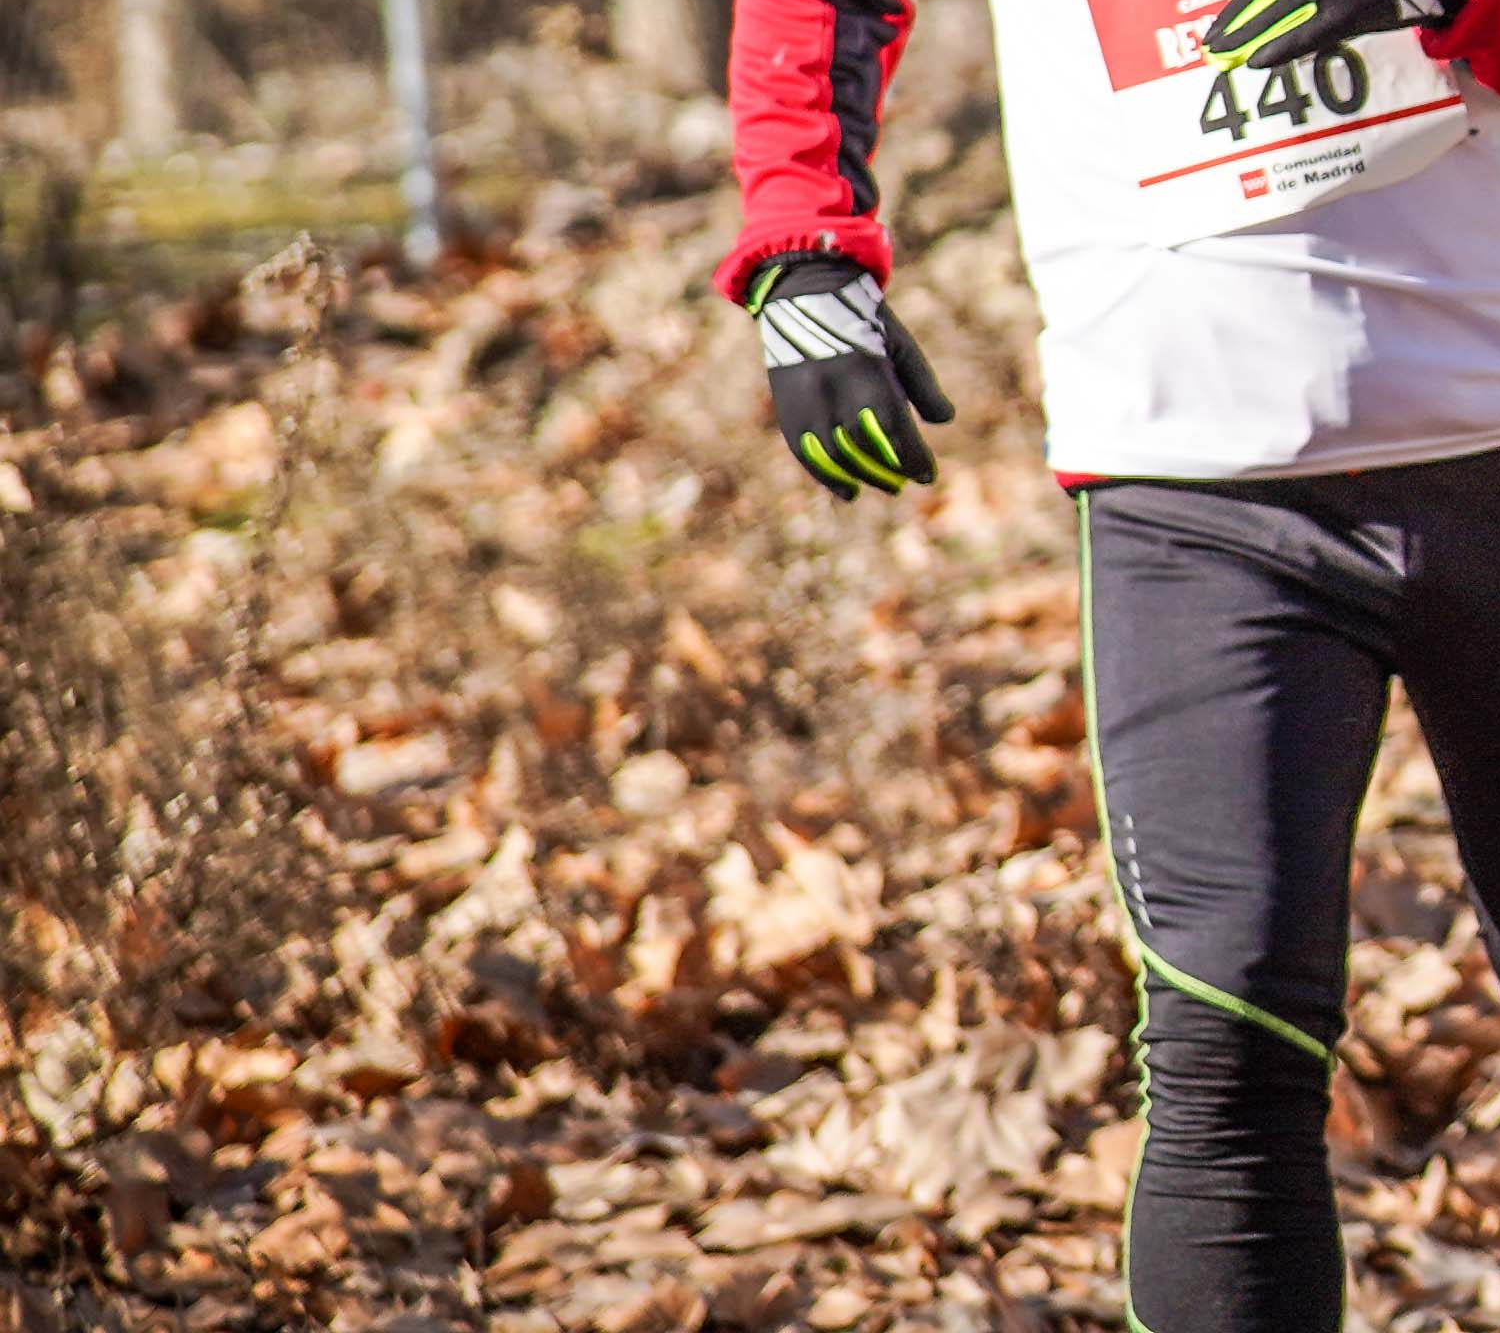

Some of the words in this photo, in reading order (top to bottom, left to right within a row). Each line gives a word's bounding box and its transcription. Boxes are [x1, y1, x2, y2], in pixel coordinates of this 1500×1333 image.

[1200, 47, 1370, 142] 440
[1272, 141, 1362, 174] Comunidad
[1276, 176, 1297, 193] de
[1304, 160, 1366, 185] Madrid
